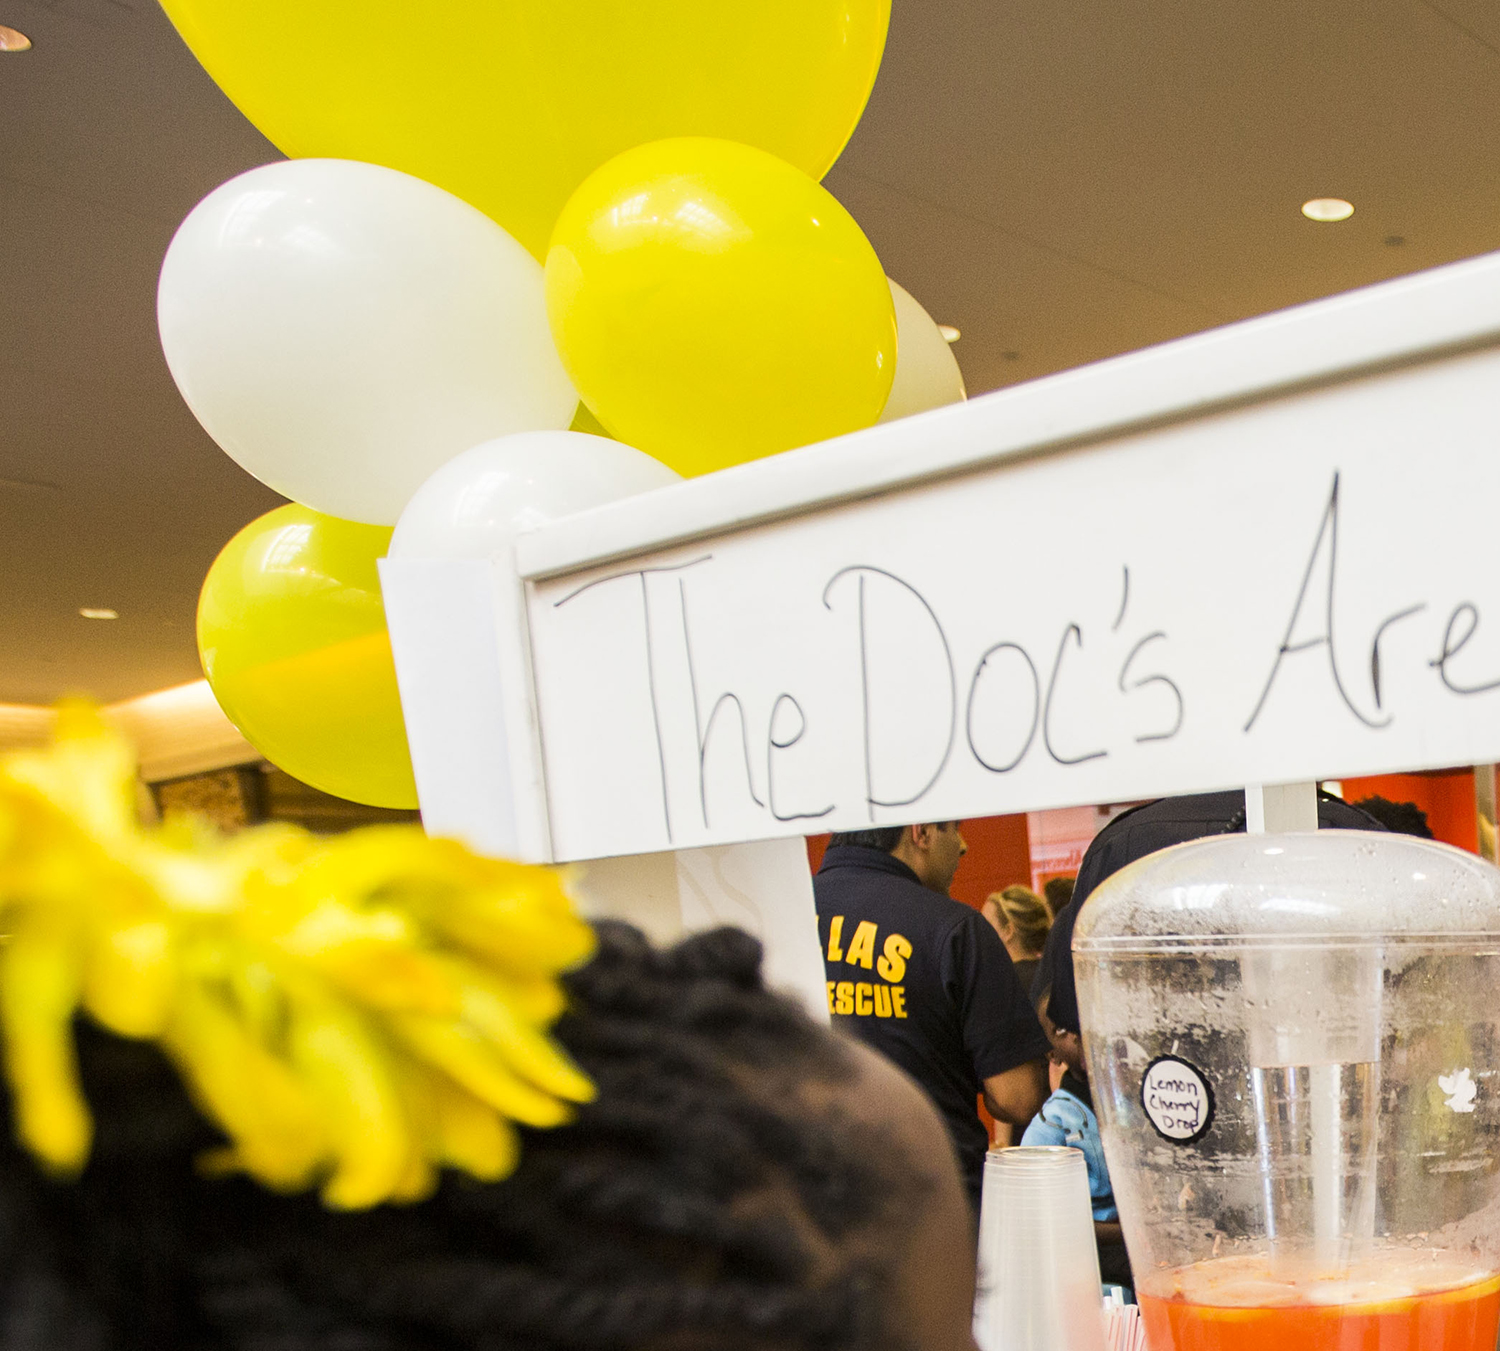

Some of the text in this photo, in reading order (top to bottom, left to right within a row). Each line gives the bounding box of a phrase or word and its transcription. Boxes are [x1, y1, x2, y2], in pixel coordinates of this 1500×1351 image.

[554, 554, 835, 844] The
[816, 914, 913, 983] LAS
[1148, 1073, 1198, 1096] Lemon
[1149, 1093, 1200, 1121] Cherry
[1162, 1115, 1199, 1135] Drop
